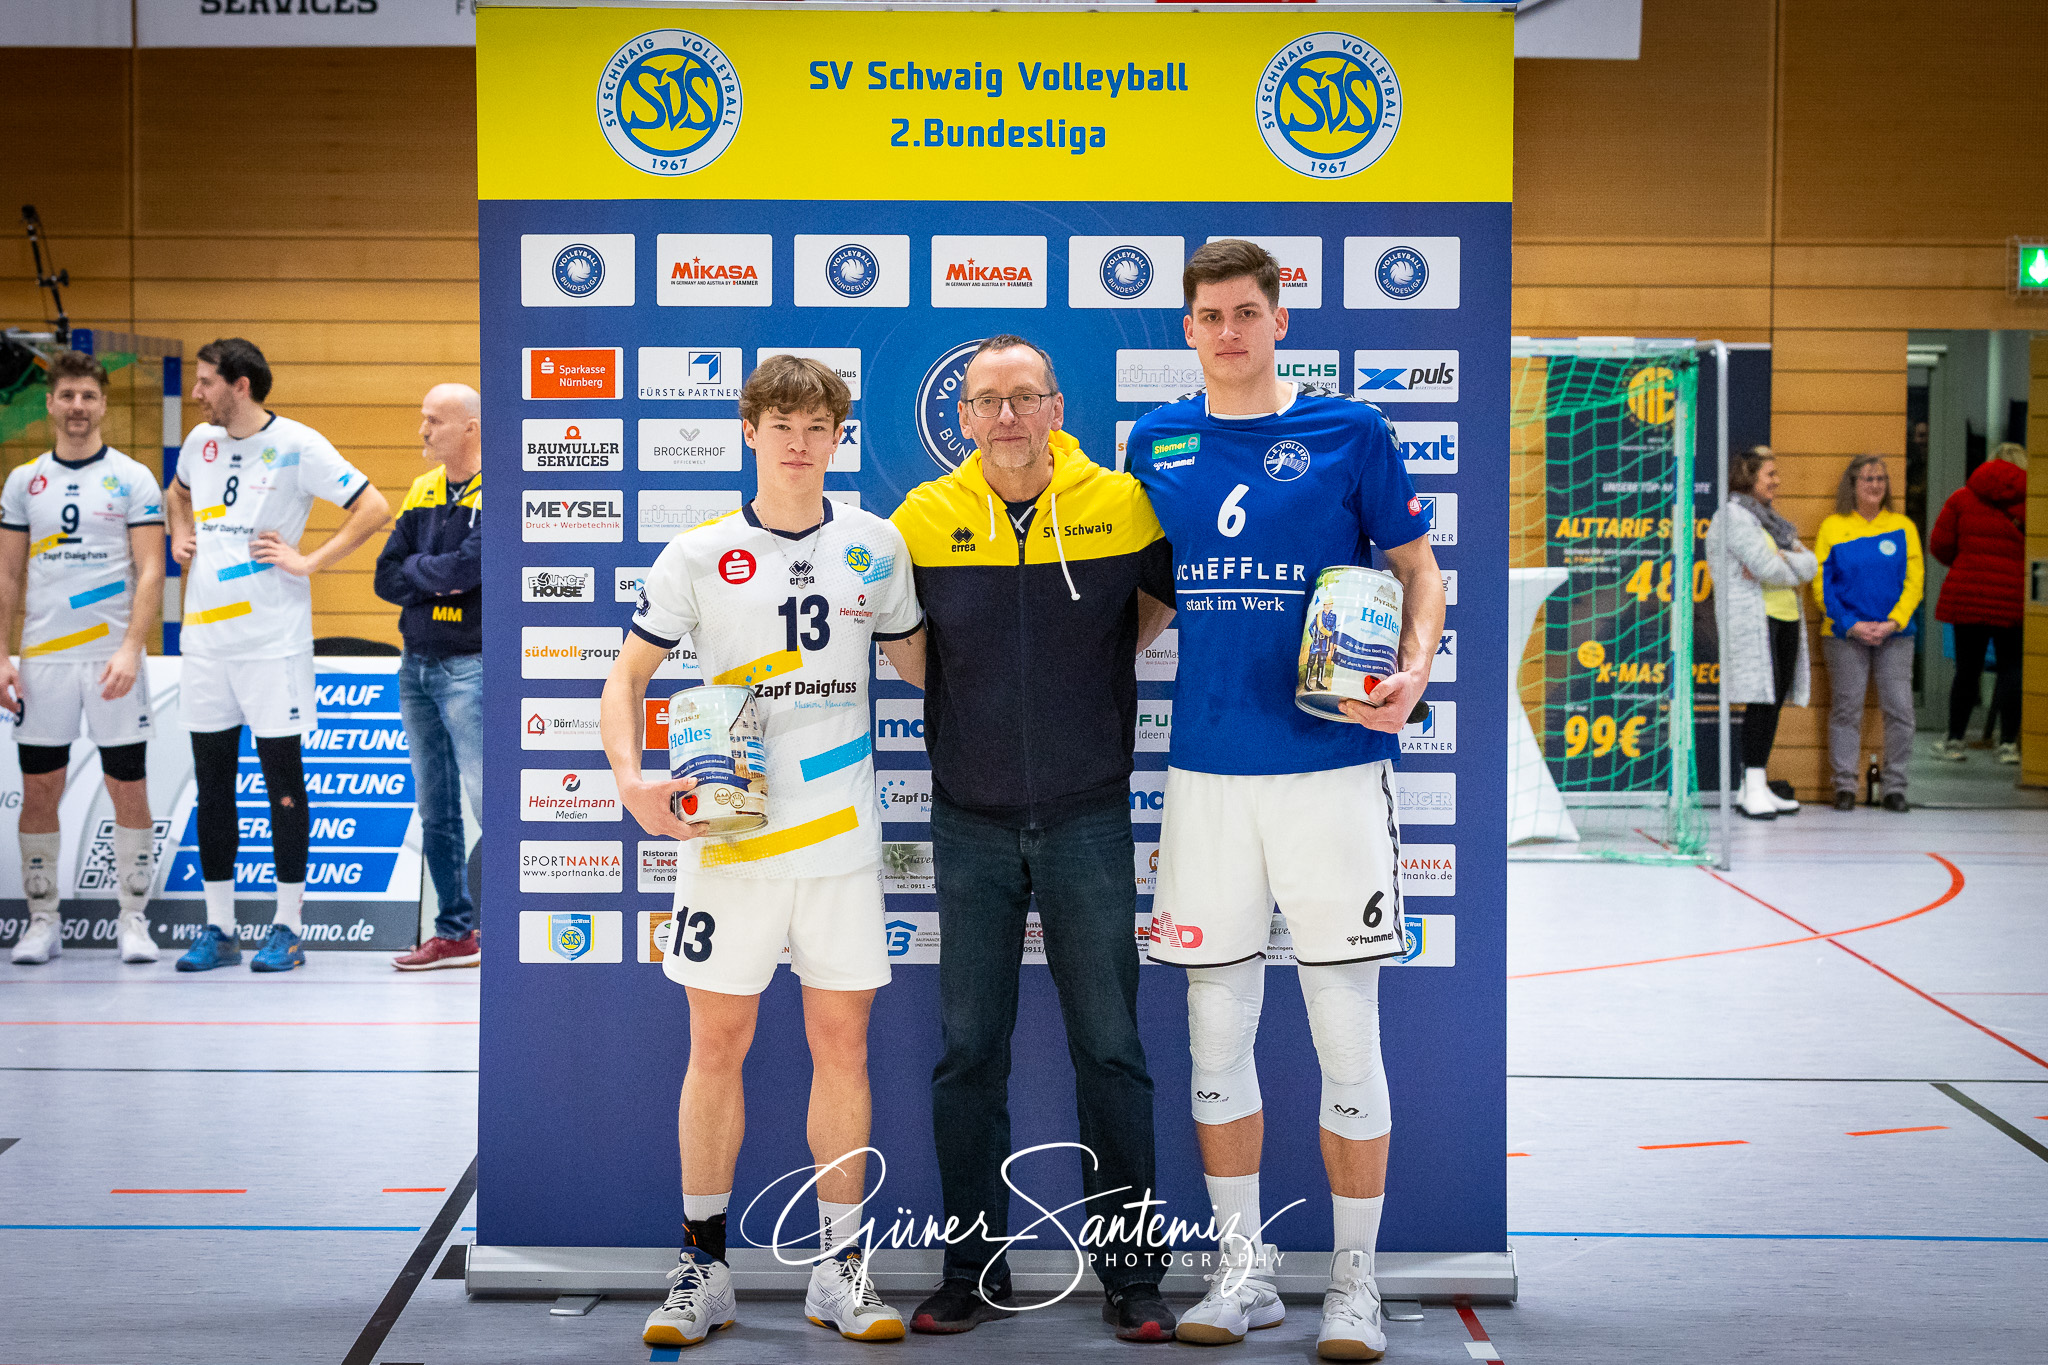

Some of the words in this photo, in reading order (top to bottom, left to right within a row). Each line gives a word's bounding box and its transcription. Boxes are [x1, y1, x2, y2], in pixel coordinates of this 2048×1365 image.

[605, 38, 655, 101] SCHWAIG
[1263, 40, 1314, 102] SCHWAIG
[681, 36, 736, 127] VOLLEYBALL
[809, 61, 853, 90] SV
[868, 61, 1003, 98] Schwaig
[1018, 62, 1189, 98] Volleyball
[1341, 39, 1397, 129] VOLLEYBALL
[605, 108, 617, 127] SV
[1263, 110, 1275, 130] SV
[890, 118, 1106, 155] 2.Bundesliga
[651, 157, 688, 171] 1967
[1310, 160, 1348, 174] 1967
[559, 250, 598, 267] VOLLEYBALL
[833, 250, 872, 267] VOLLEYBALL
[1106, 251, 1146, 268] VOLLEYBALL
[1381, 252, 1421, 269] VOLLEYBALL
[560, 276, 598, 292] BUNDESLIGA
[833, 276, 872, 292] BUNDESLIGA
[1107, 278, 1146, 294] BUNDESLIGA
[1382, 279, 1422, 295] BUNDESLIGA
[559, 365, 606, 376] Sparkasse
[1118, 364, 1205, 383] HÜTTINGE
[1277, 363, 1337, 376] UCHS
[559, 377, 603, 388] Nürnberg
[640, 387, 676, 397] FÜRST
[678, 388, 685, 397] &
[688, 388, 739, 397] PARTNER
[653, 446, 726, 456] BROCKERHOF
[1280, 443, 1308, 461] VOLLEYS
[537, 456, 609, 467] SERVICES
[1162, 456, 1196, 470] hummel
[223, 475, 239, 507] 8
[526, 501, 621, 518] MEYSEL
[1217, 483, 1250, 538] 6
[61, 503, 80, 534] 9
[526, 521, 550, 529] Druck
[560, 521, 620, 529] Werbetechnik
[1064, 521, 1113, 537] Schwaig
[1555, 517, 1653, 539] ALTTARIF
[951, 542, 976, 553] errea
[533, 586, 583, 597] HOUSE
[1186, 596, 1214, 612] stark
[1217, 597, 1238, 611] im
[1241, 597, 1285, 612] Werk
[432, 606, 462, 622] MM
[1360, 606, 1400, 637] Helles
[778, 594, 831, 652] 13
[1596, 663, 1666, 684] X-MAS
[754, 681, 791, 700] Zapf
[794, 679, 857, 697] Daigfuss
[553, 718, 601, 729] DörrMassiv
[669, 727, 712, 750] Helles
[1138, 730, 1165, 739] Ideen
[1565, 715, 1646, 758] 99€
[1401, 742, 1453, 751] PARTNER
[235, 773, 406, 795] VEALTUNG
[528, 795, 616, 808] Heinzelmann
[891, 792, 919, 805] Zapf
[555, 811, 588, 819] Medien
[523, 855, 621, 867] SPORTNANKA
[523, 868, 621, 880] www.sportnanka.de
[653, 874, 666, 882] fon
[1362, 890, 1385, 928] 6
[673, 905, 716, 962] 13
[1359, 930, 1394, 946] hummel
